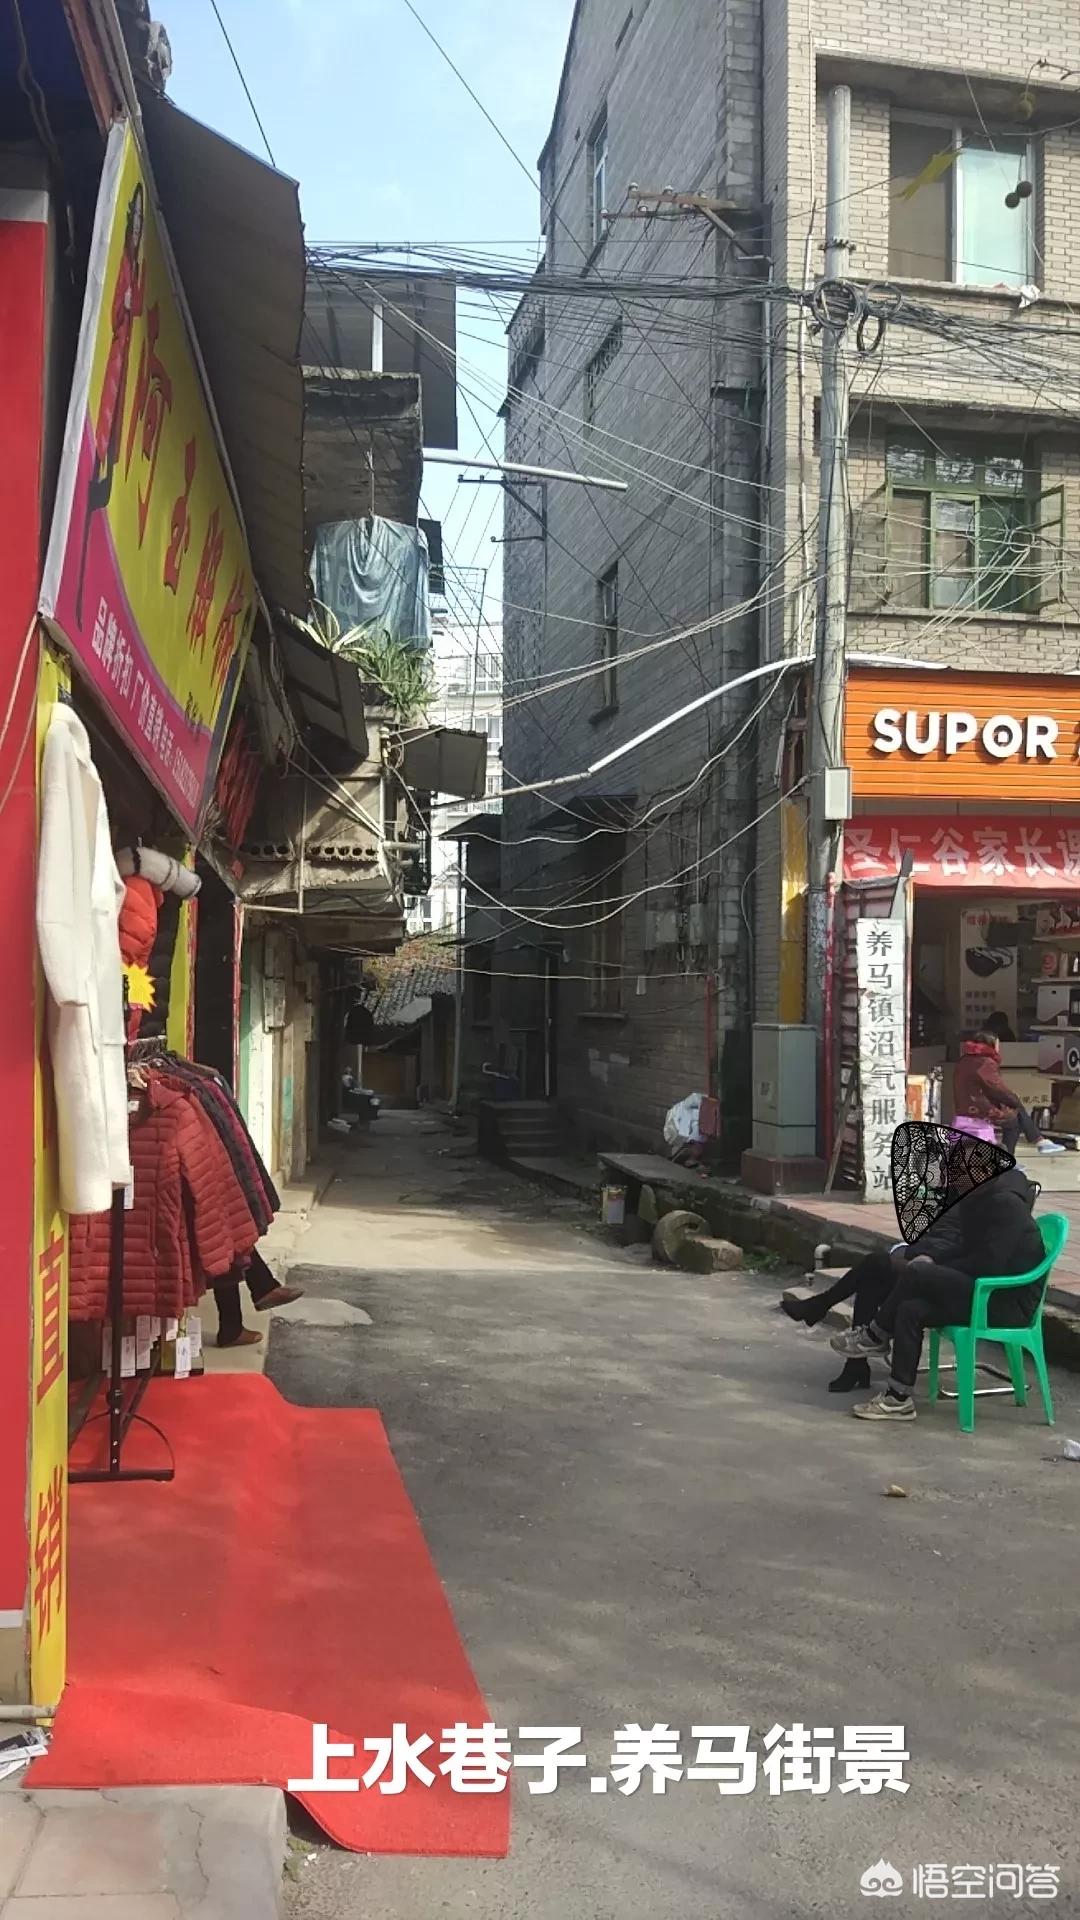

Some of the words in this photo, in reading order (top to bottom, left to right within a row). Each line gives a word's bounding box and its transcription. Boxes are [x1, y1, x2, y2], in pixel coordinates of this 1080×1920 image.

[91, 596, 134, 698] 品牌折扣
[873, 708, 1060, 759] SUPOR
